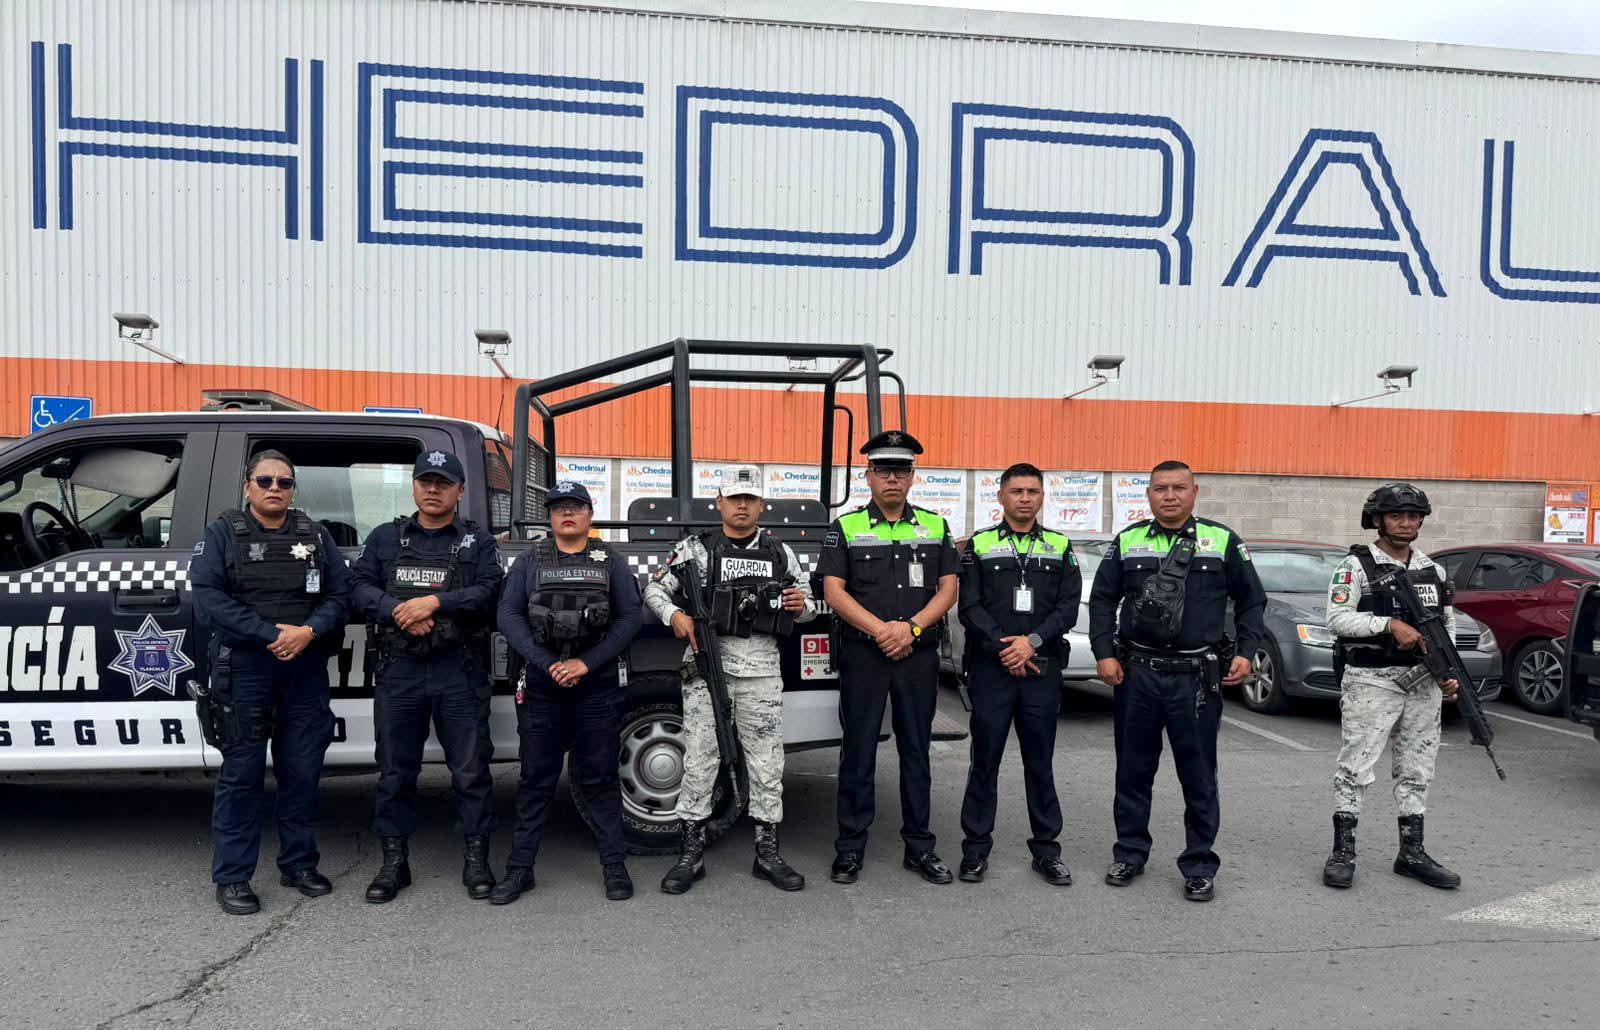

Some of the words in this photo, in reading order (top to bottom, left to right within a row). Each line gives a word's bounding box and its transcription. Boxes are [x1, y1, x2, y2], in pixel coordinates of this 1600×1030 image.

[568, 463, 606, 472] Chedraui
[642, 466, 672, 475] Chedra
[784, 471, 820, 480] Chedraui
[927, 475, 962, 483] Chedraui
[1063, 476, 1098, 484] Chedraui
[725, 559, 768, 573] GUARDIA
[573, 569, 604, 579] ESTATAL
[806, 640, 830, 653] 91
